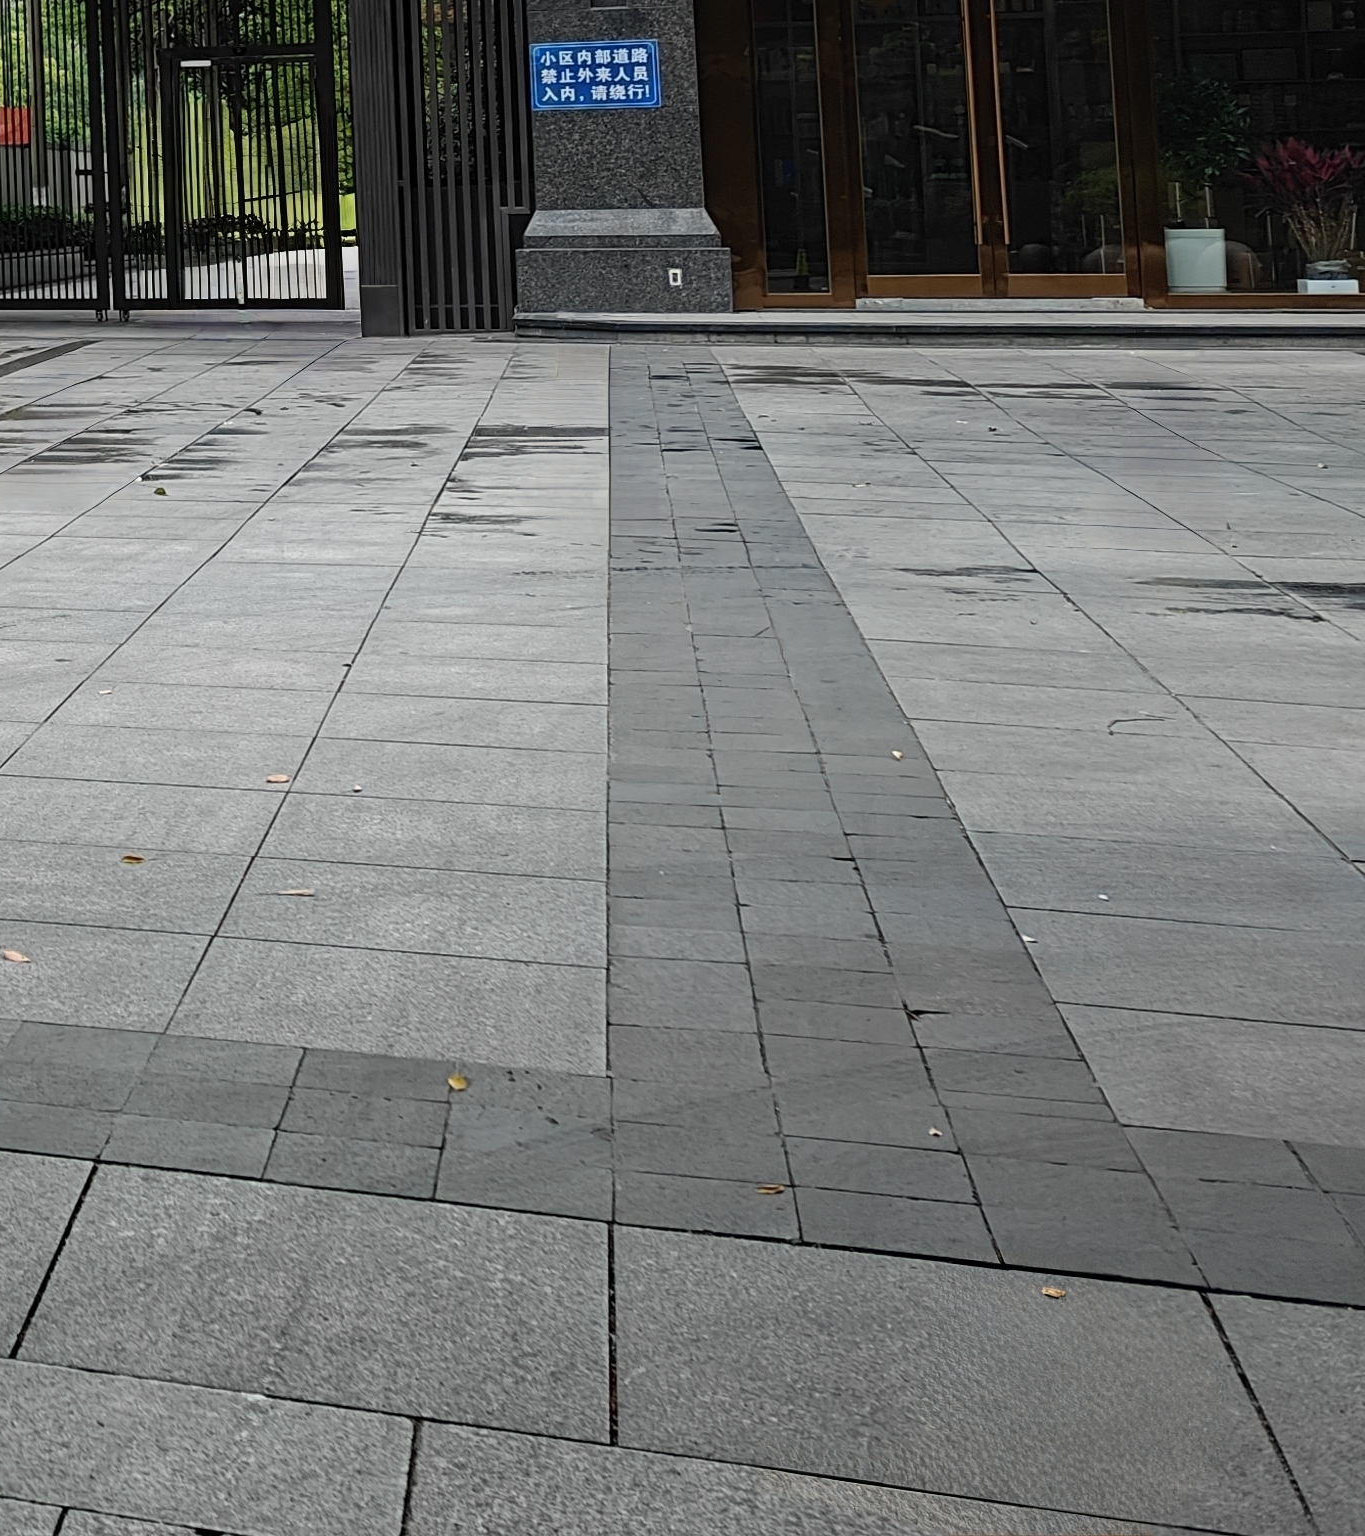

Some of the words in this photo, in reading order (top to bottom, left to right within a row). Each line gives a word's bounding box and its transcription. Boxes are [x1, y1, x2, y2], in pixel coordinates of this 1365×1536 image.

[540, 47, 649, 66] 小区内部道路
[540, 66, 649, 84] 禁止外来人员
